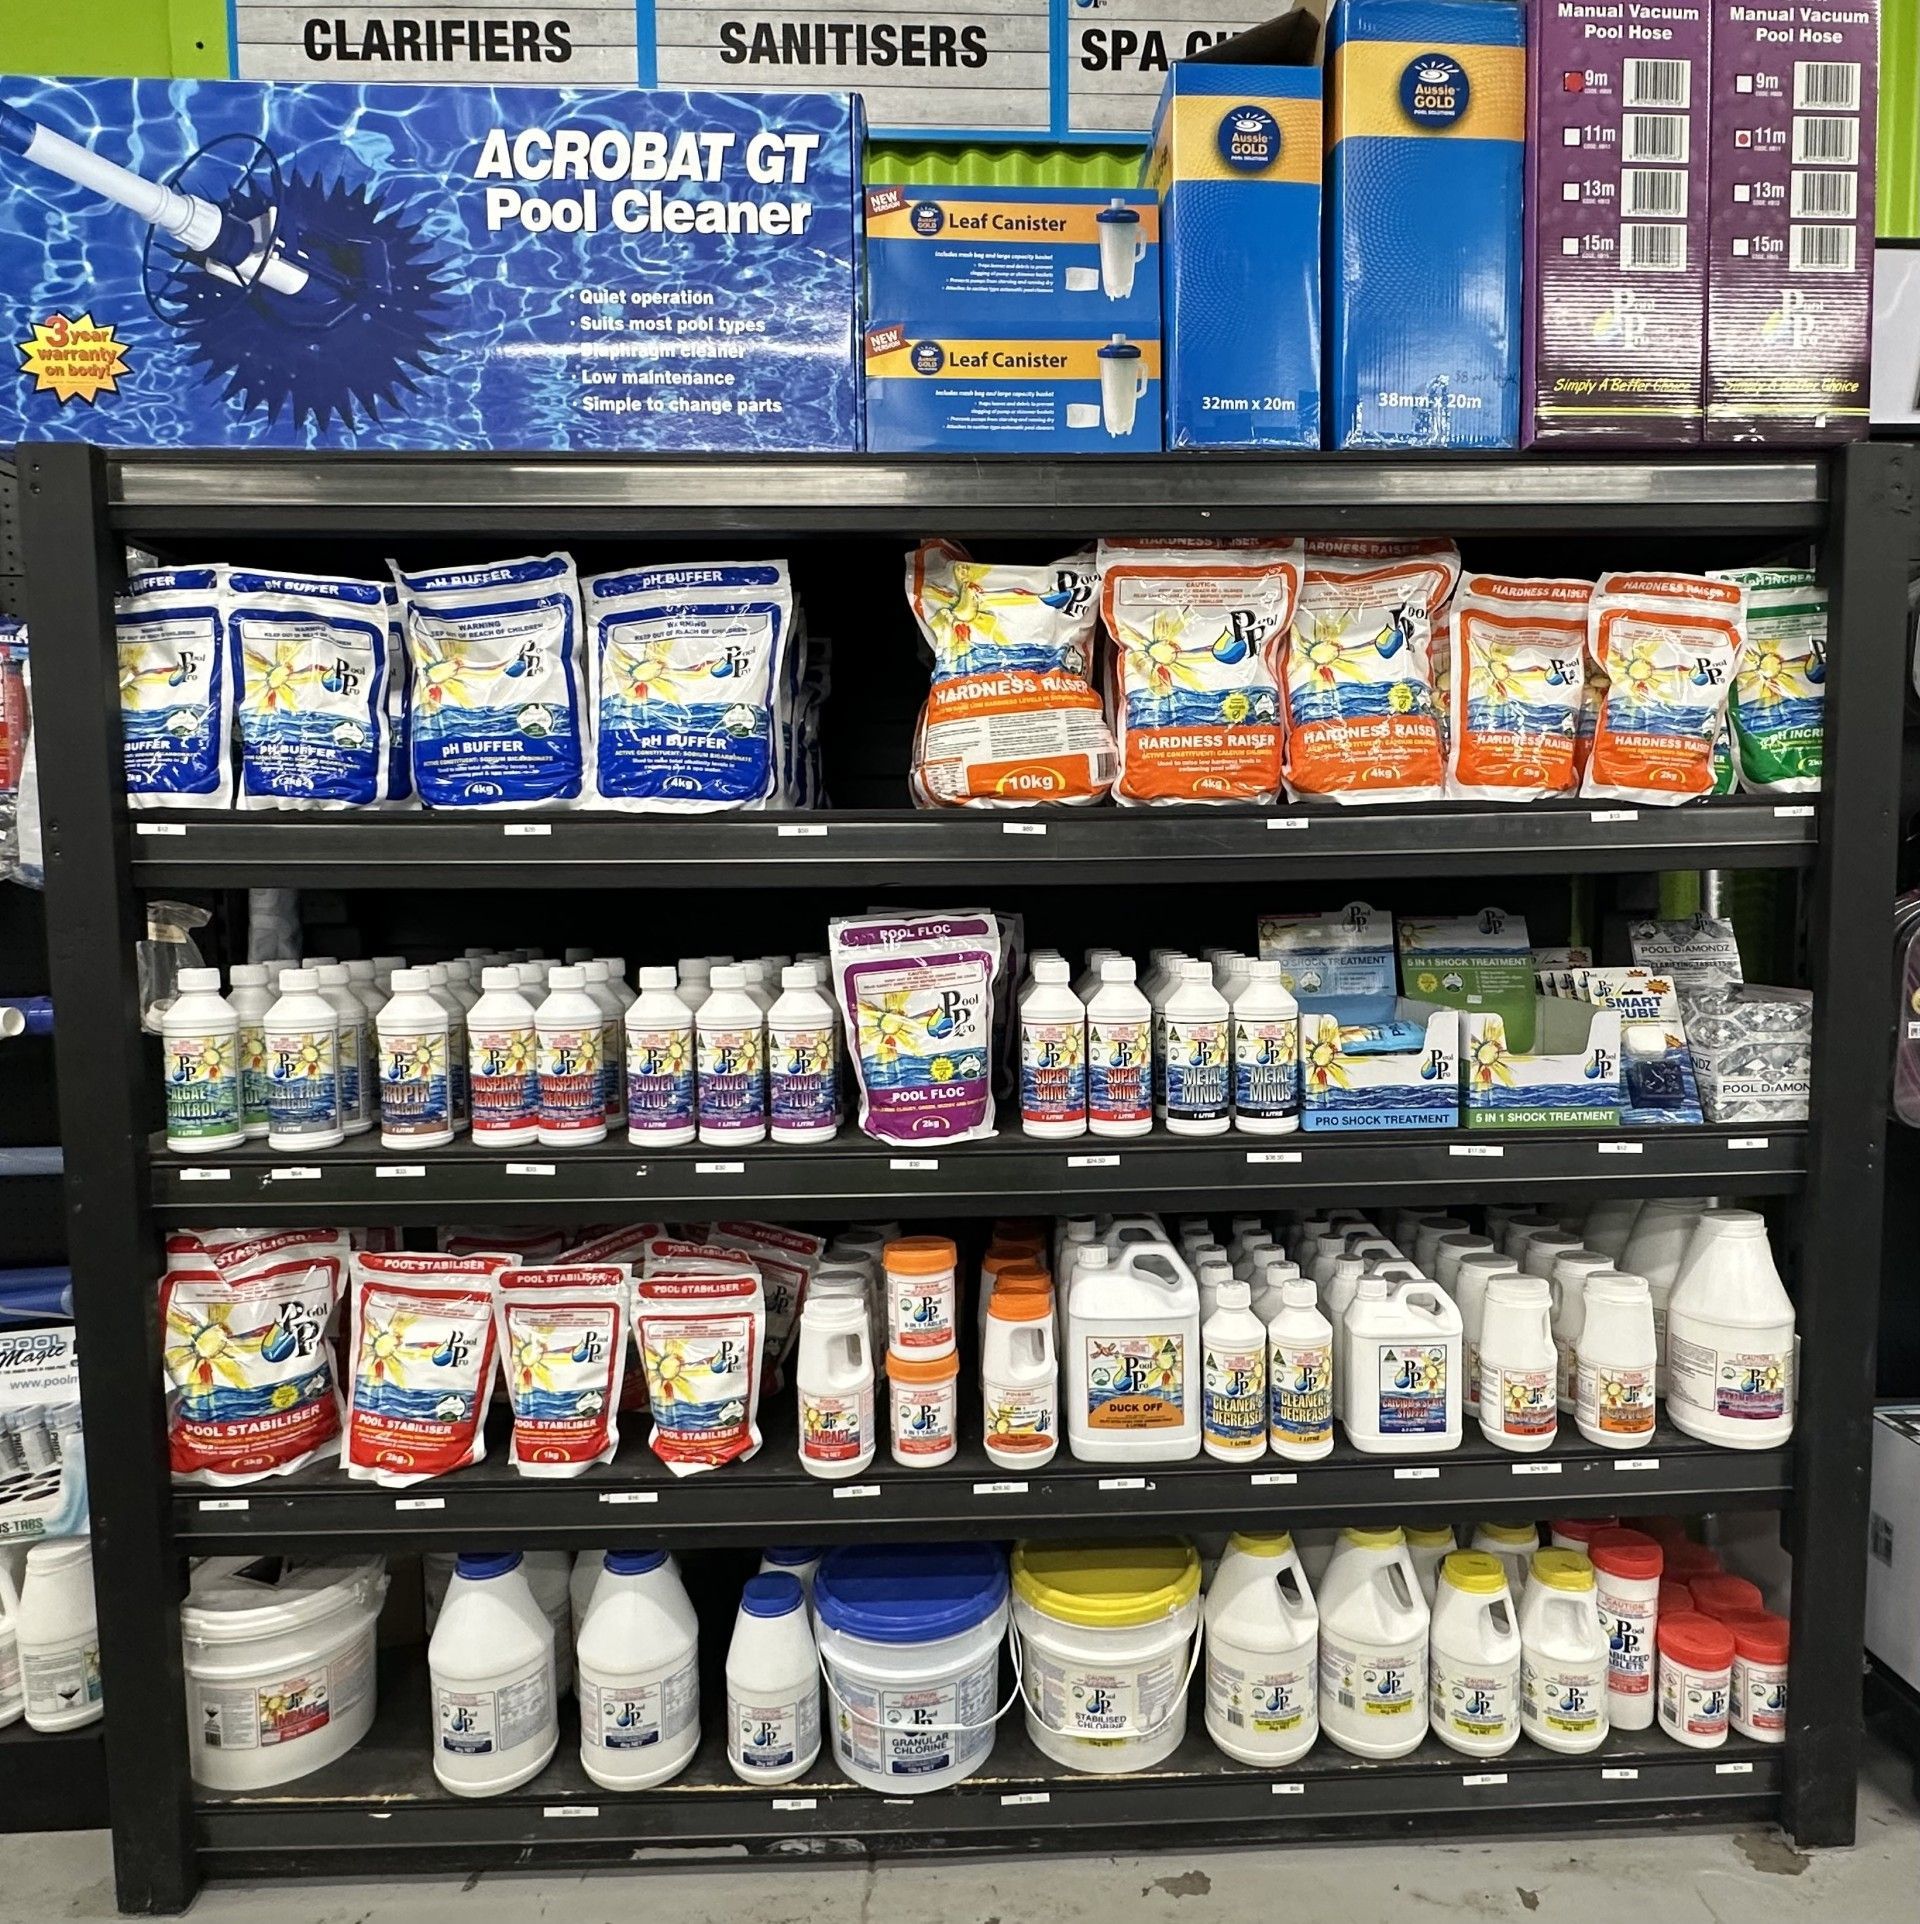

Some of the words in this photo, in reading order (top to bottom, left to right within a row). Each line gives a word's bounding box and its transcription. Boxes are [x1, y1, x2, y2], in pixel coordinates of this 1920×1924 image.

[1558, 3, 1624, 18] Manual
[1628, 4, 1700, 20] Vacuum
[1730, 6, 1795, 21] Manual
[1799, 7, 1870, 24] Vacuum
[1584, 24, 1623, 39] Pool
[1628, 25, 1673, 40] Hose
[1756, 27, 1794, 42] Pool
[1799, 28, 1843, 43] Hose
[303, 19, 572, 63] CLARIFIERS
[720, 21, 988, 68] SANITISERS
[1081, 29, 1169, 71] SPA
[1585, 69, 1608, 86] 9m
[1755, 72, 1779, 89] 9m
[1415, 83, 1456, 96] Aussie
[1414, 95, 1455, 108] GOLD
[1232, 132, 1268, 143] Aussie
[1583, 125, 1616, 142] 11m
[1754, 127, 1786, 144] 11m
[475, 128, 735, 182] ACROBAT
[745, 133, 820, 185] GT
[1232, 143, 1267, 155] GOLD
[1583, 180, 1615, 196] 13m
[1753, 182, 1784, 198] 13m
[870, 190, 898, 207] NEW
[486, 188, 597, 232] Pool
[611, 188, 812, 235] Cleaner
[949, 213, 988, 230] Leaf
[992, 214, 1067, 232] Canister
[1582, 235, 1614, 250] 15m
[1752, 236, 1784, 252] 15m
[579, 290, 626, 305] Quiet
[631, 291, 714, 308] operation
[45, 315, 69, 348] 3
[70, 330, 110, 345] year
[580, 316, 624, 332] Suits
[629, 318, 673, 332] most
[677, 317, 714, 336] pool
[718, 317, 765, 336] types
[870, 329, 898, 348] NEW
[37, 347, 117, 365] warranty
[680, 342, 746, 359] cleaner
[949, 352, 988, 367] Leaf
[993, 352, 1067, 368] Canister
[45, 365, 65, 377] on
[68, 363, 111, 379] body!
[582, 371, 617, 386] Low
[622, 371, 735, 386] maintenance
[1554, 379, 1597, 395] Simply
[1820, 378, 1859, 393] Choice
[582, 397, 642, 415] Simple
[646, 399, 664, 412] to
[668, 398, 732, 416] change
[736, 398, 783, 416] parts
[1202, 397, 1248, 410] 32mm
[1251, 400, 1261, 410] x
[1263, 398, 1296, 412] 20m
[1379, 392, 1430, 408] 38mm
[1447, 394, 1482, 409] 20m
[643, 573, 662, 588] pH
[664, 570, 723, 584] BUFFER
[1623, 580, 1684, 594] HARDNESS
[1492, 585, 1549, 598] HARDNESS
[1552, 588, 1588, 600] RAISER
[458, 620, 501, 631] WARNING
[936, 678, 1037, 705] HARDNESS
[641, 735, 661, 749] pH
[666, 734, 727, 750] BUFFER
[1138, 735, 1223, 750] HARDNESS
[1227, 733, 1276, 748] RAISER
[1303, 725, 1390, 745] HARDNESS
[1615, 736, 1683, 750] HARDNESS
[442, 743, 459, 758] pH
[463, 740, 524, 754] BUFFER
[1370, 766, 1392, 779] 4kg
[472, 784, 494, 795] 4kg
[671, 777, 693, 790] 4kg
[1009, 774, 1054, 791] 10kg
[1201, 779, 1223, 790] 4kg
[879, 925, 915, 941] POOL
[917, 923, 951, 936] FLOC
[1641, 945, 1671, 954] POOL
[1328, 955, 1386, 967] TREATMENT
[1434, 958, 1469, 967] SHOCK
[1472, 957, 1527, 967] TREATMENT
[1605, 996, 1662, 1008] SMART
[1035, 1068, 1068, 1085] SUPER
[1107, 1068, 1140, 1084] SUPER
[1183, 1068, 1222, 1085] METAL
[1250, 1067, 1289, 1084] METAL
[892, 1089, 930, 1103] POOL
[932, 1086, 966, 1099] FLOC
[1036, 1084, 1068, 1101] SHINE
[1108, 1084, 1141, 1101] SHINE
[1182, 1085, 1223, 1104] MINUS
[1250, 1084, 1291, 1103] MINUS
[1722, 1084, 1758, 1093] POOL
[1315, 1116, 1339, 1126] PRO
[1342, 1115, 1380, 1125] SHOCK
[1383, 1114, 1450, 1125] TREATMENT
[1476, 1112, 1482, 1122] 5
[1484, 1112, 1497, 1122] IN
[1508, 1112, 1547, 1122] SHOCK
[1550, 1110, 1614, 1121] TREATMENT
[384, 1258, 415, 1270] POOL
[417, 1259, 485, 1271] STABILISER
[517, 1274, 544, 1284] POOL
[681, 1283, 740, 1295] STABILISER
[1109, 1403, 1139, 1413] DUCK
[1143, 1402, 1163, 1412] OFF
[1212, 1396, 1256, 1412] CLEANER
[1281, 1391, 1324, 1408] CLEANER
[185, 1423, 224, 1438] POOL
[226, 1404, 321, 1437] STABILISER
[358, 1413, 384, 1427] POOL
[386, 1418, 453, 1435] STABILISER
[514, 1418, 536, 1430] POOL
[537, 1417, 597, 1430] STABILISER
[810, 1429, 850, 1444] IMPACT
[1075, 1713, 1127, 1725] STABILISED
[892, 1732, 950, 1747] GRANULAR
[893, 1742, 948, 1756] CHLORINE
